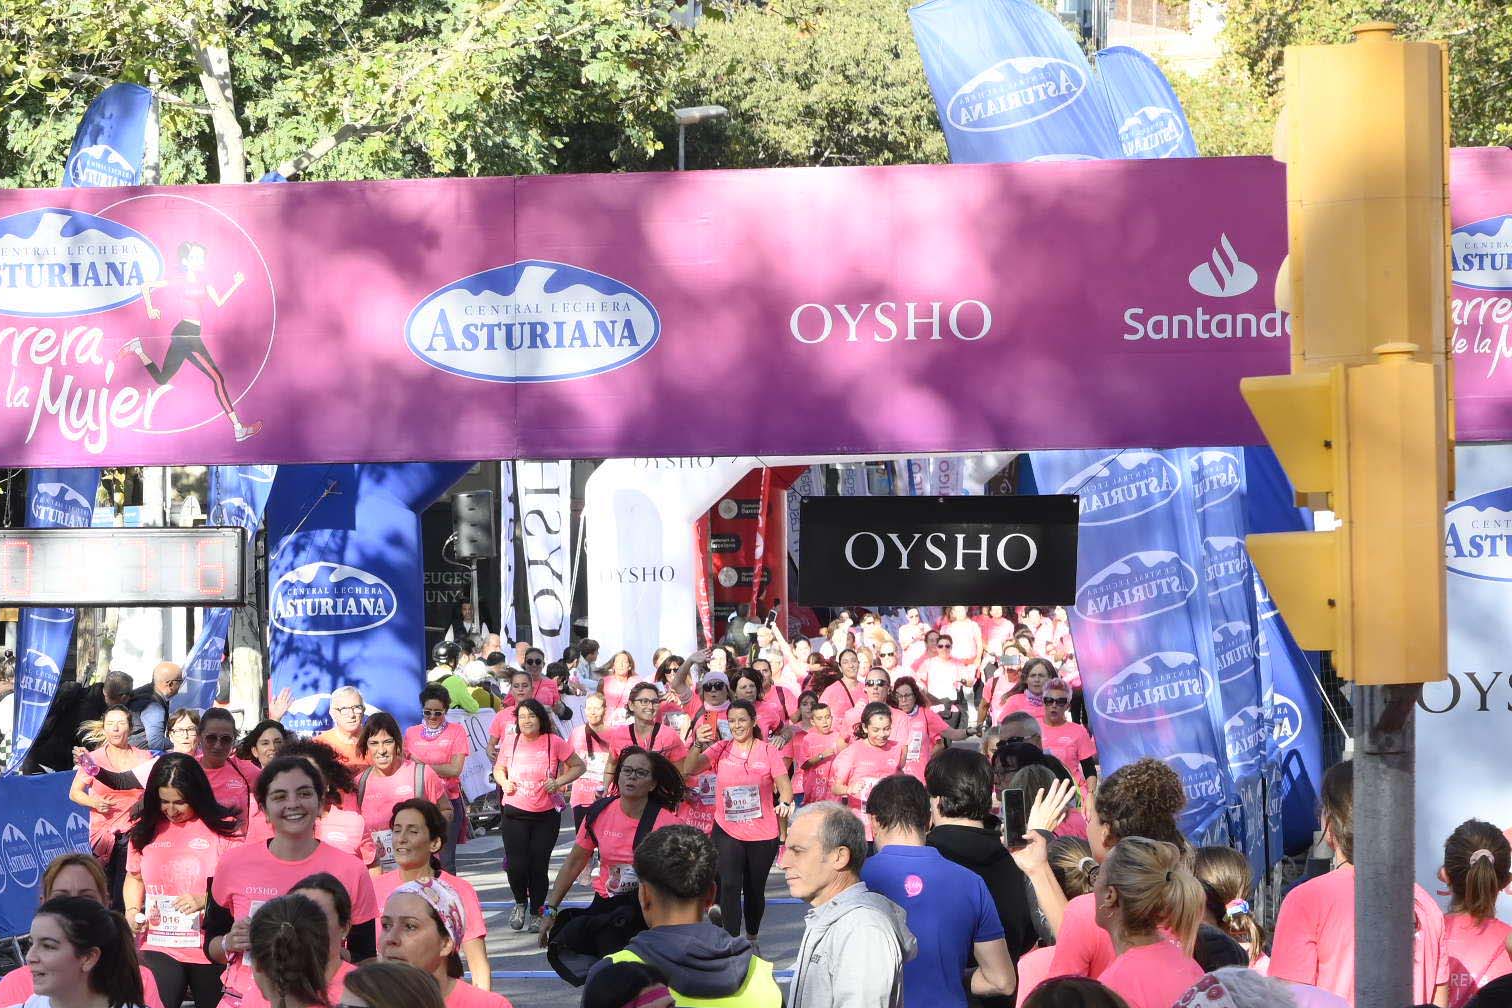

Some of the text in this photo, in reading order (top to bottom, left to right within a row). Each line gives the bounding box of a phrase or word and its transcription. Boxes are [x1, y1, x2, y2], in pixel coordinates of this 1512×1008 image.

[67, 244, 140, 256] LECHERA
[464, 300, 633, 316] CENTRAL LECHERA
[424, 307, 641, 352] ASTURIANA
[789, 299, 993, 345] OYSHO
[1473, 325, 1492, 354] la
[4, 367, 32, 408] la
[25, 359, 175, 454] Mujer
[843, 530, 1039, 573] OYSHO
[287, 586, 384, 597] CENTRAL LECHERA
[274, 593, 387, 619] ASTURIANA
[288, 719, 329, 727] CENTRAL
